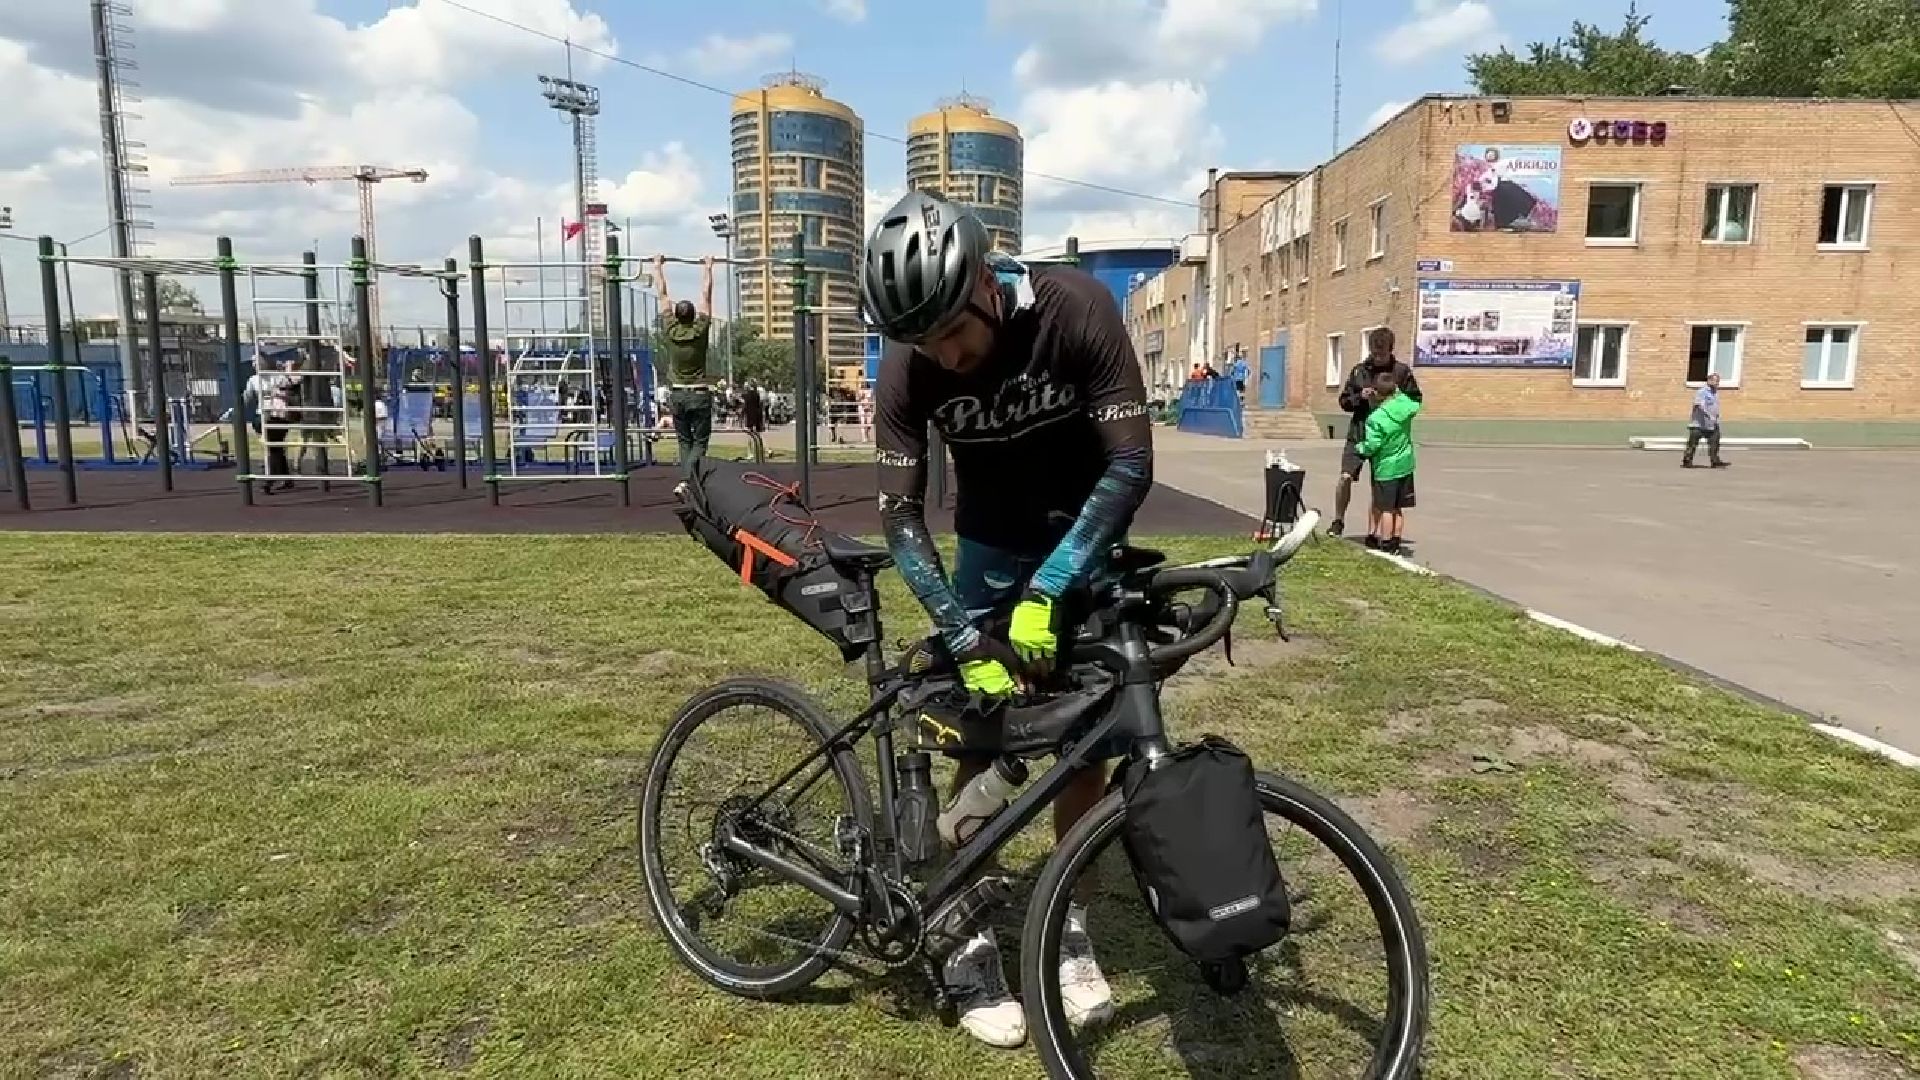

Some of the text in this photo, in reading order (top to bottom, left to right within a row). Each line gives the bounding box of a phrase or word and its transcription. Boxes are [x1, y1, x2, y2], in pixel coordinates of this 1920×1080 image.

[1506, 159, 1558, 170] АЙКИДО
[921, 204, 940, 257] MET
[935, 384, 1076, 433] Purito
